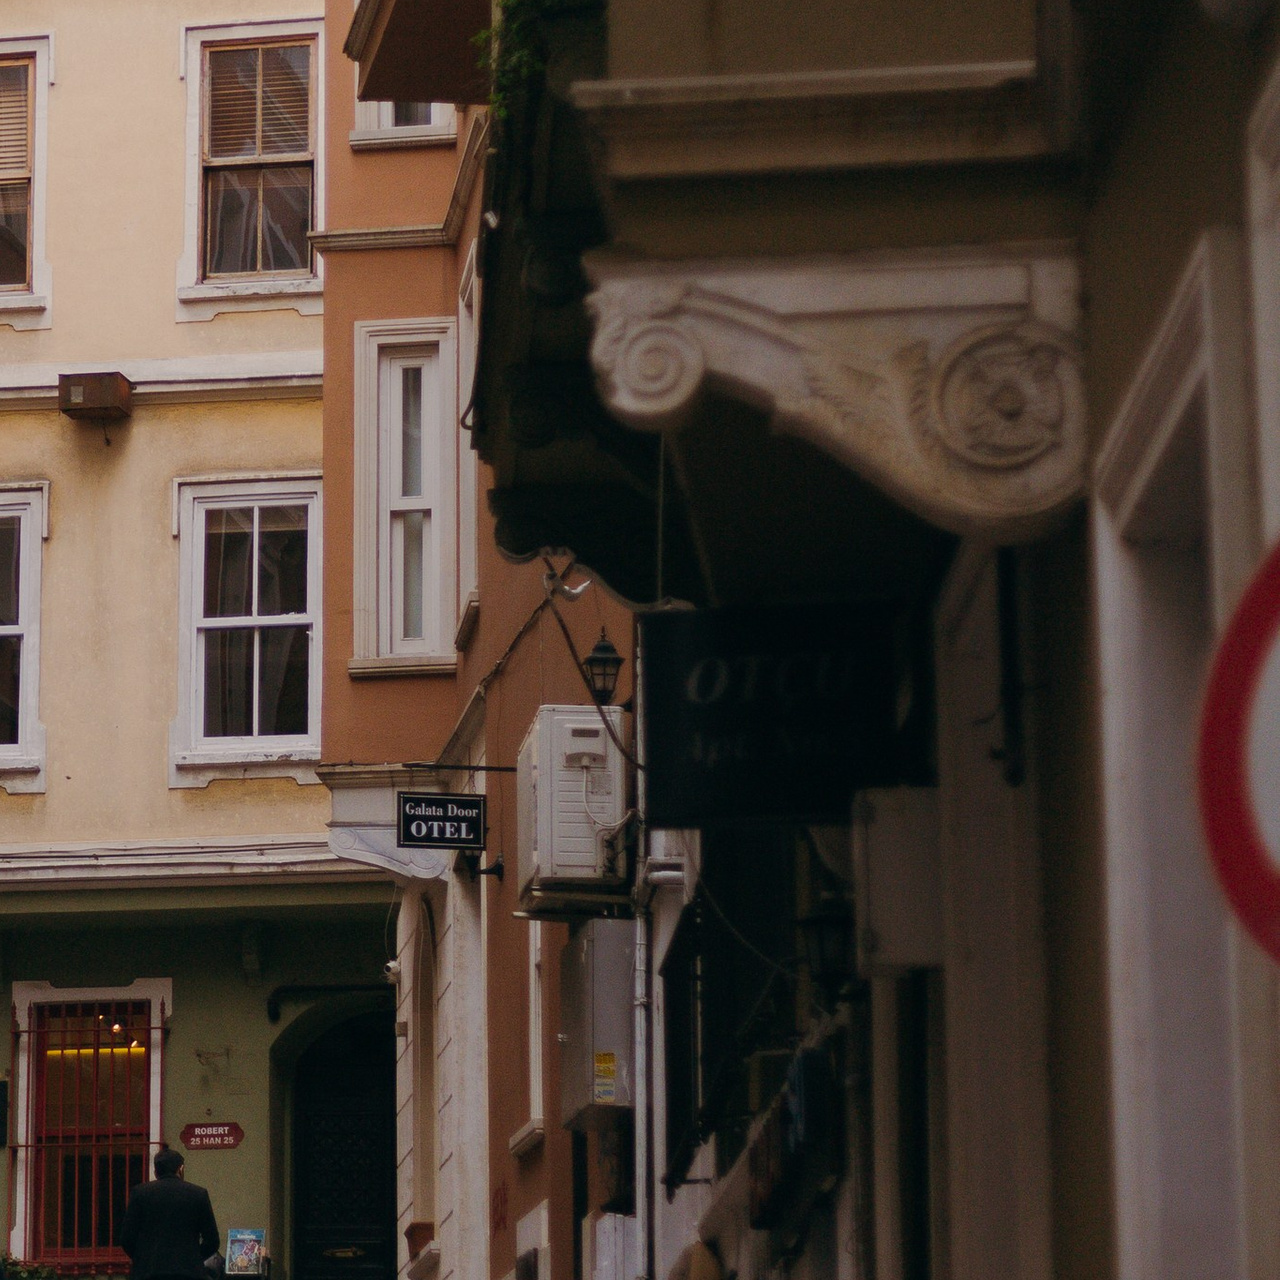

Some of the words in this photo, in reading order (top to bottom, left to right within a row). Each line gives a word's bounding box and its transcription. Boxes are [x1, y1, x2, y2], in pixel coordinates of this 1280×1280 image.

[405, 802, 443, 816] Galata
[447, 803, 479, 818] Door
[410, 820, 474, 839] OTEL
[194, 1126, 230, 1135] ROBERT
[190, 1137, 201, 1145] 25
[202, 1137, 222, 1145] HAN
[223, 1136, 234, 1144] 25
